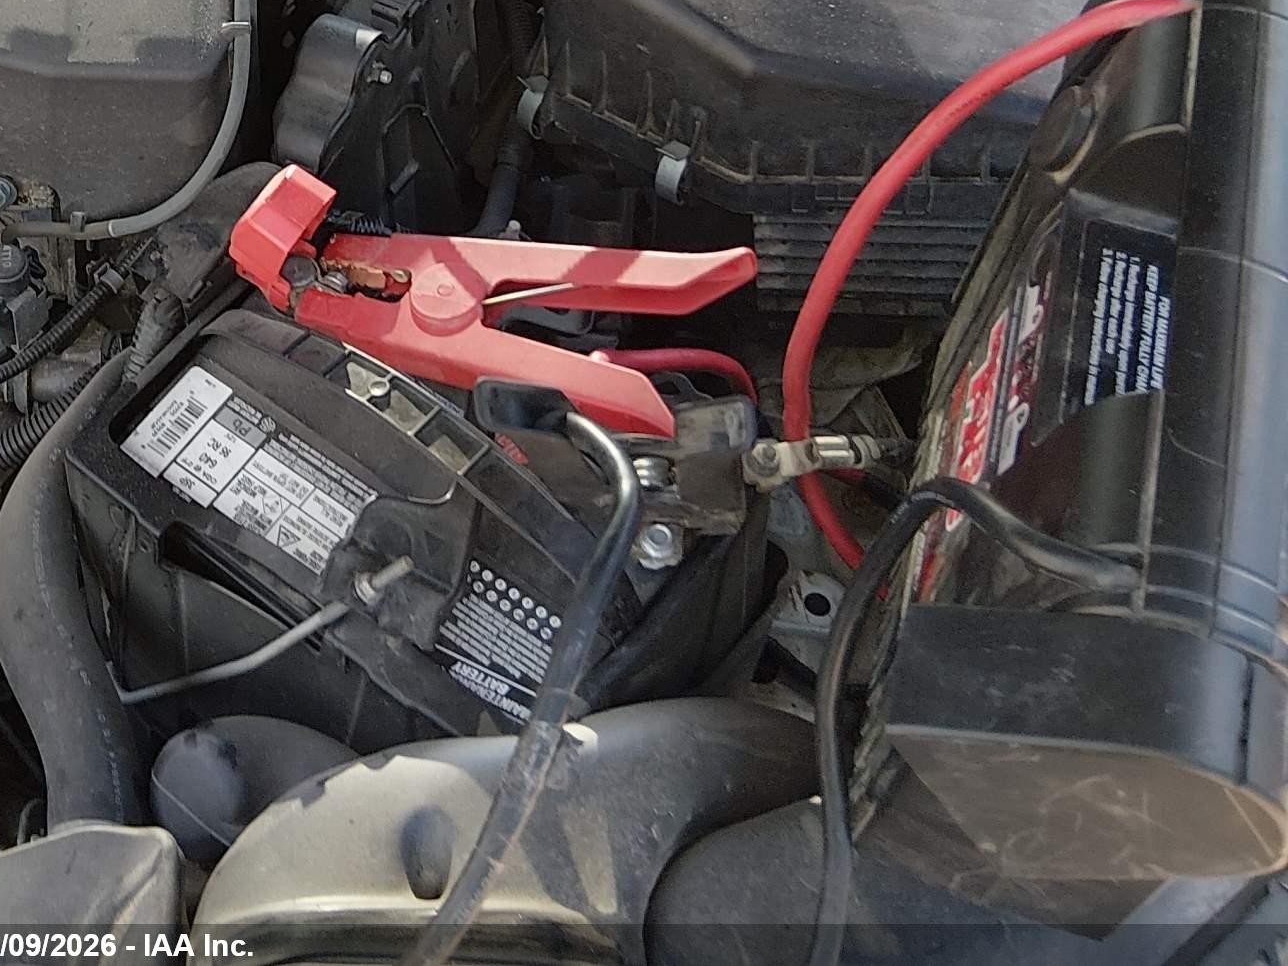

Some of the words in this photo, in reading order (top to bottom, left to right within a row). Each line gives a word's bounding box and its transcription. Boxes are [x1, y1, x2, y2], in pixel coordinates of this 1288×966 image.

[1146, 265, 1159, 292] KEEP
[1141, 291, 1157, 336] BATTERY
[1158, 295, 1171, 318] FOR
[1138, 334, 1153, 367] FULLY
[1153, 317, 1169, 367] MAXIMUM
[1150, 365, 1164, 389] LIFE
[232, 418, 252, 437] Pb
[451, 661, 510, 694] BATTERY
